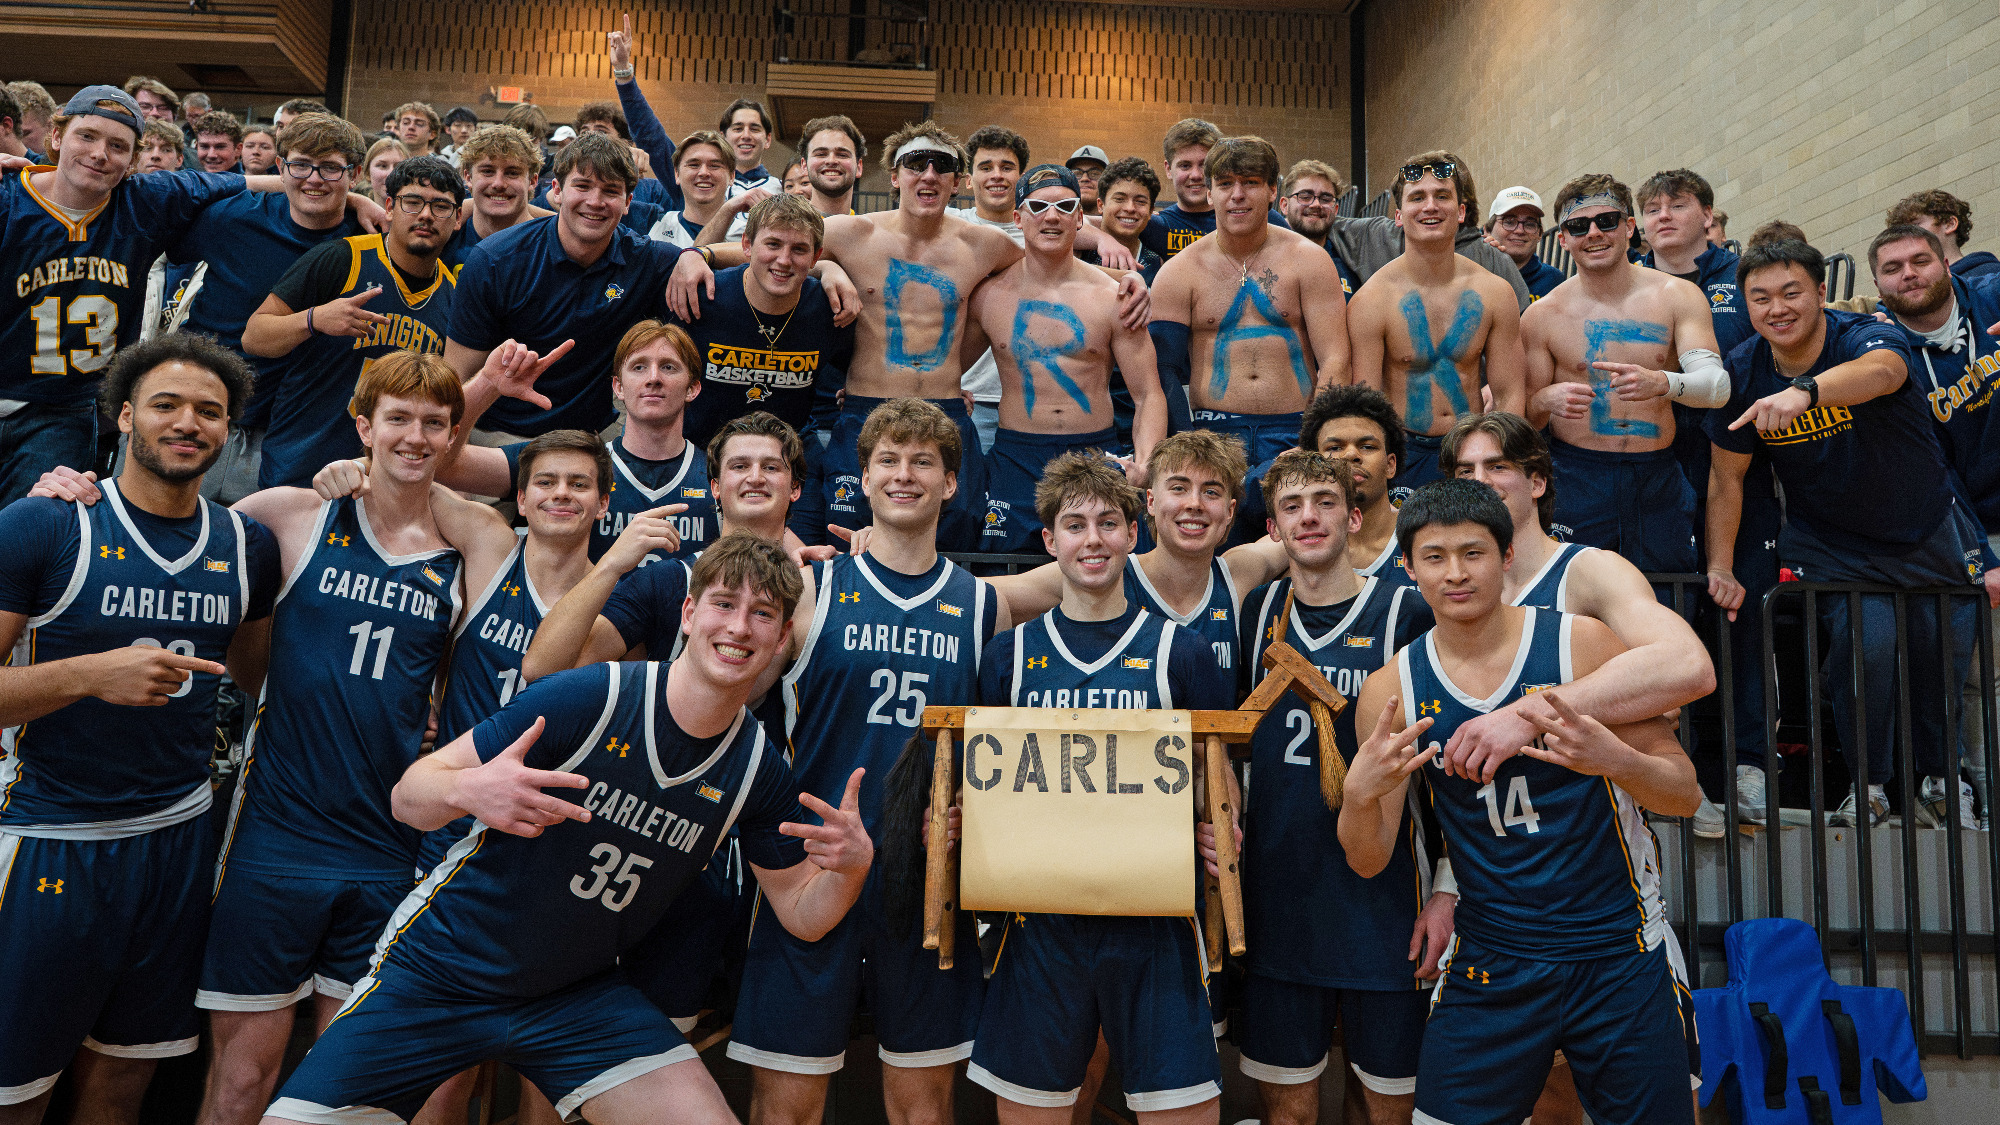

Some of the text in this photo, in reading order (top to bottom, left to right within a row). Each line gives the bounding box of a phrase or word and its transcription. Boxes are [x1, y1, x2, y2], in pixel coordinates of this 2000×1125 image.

[17, 256, 130, 298] CARLETON
[1707, 283, 1737, 291] CARLETON
[30, 294, 120, 376] 13
[705, 362, 813, 387] BASKETBALL
[707, 347, 820, 373] CARLETON
[830, 503, 857, 513] FOOTBALL
[100, 584, 230, 625] CARLETON
[319, 566, 439, 622] CARLETON
[348, 620, 396, 681] 11
[480, 612, 534, 656] CARL
[843, 623, 960, 664] CARLETON
[1346, 636, 1372, 648] MIAC
[1123, 657, 1150, 669] MIAC
[497, 667, 528, 708] 1
[866, 668, 930, 728] 25
[1026, 688, 1149, 710] CARLETON
[1284, 708, 1317, 766] 2
[965, 732, 1191, 795] CARLS
[697, 783, 723, 803] MIAC
[1476, 775, 1541, 837] 14
[582, 781, 705, 854] CARLETON
[569, 842, 655, 913] 35
